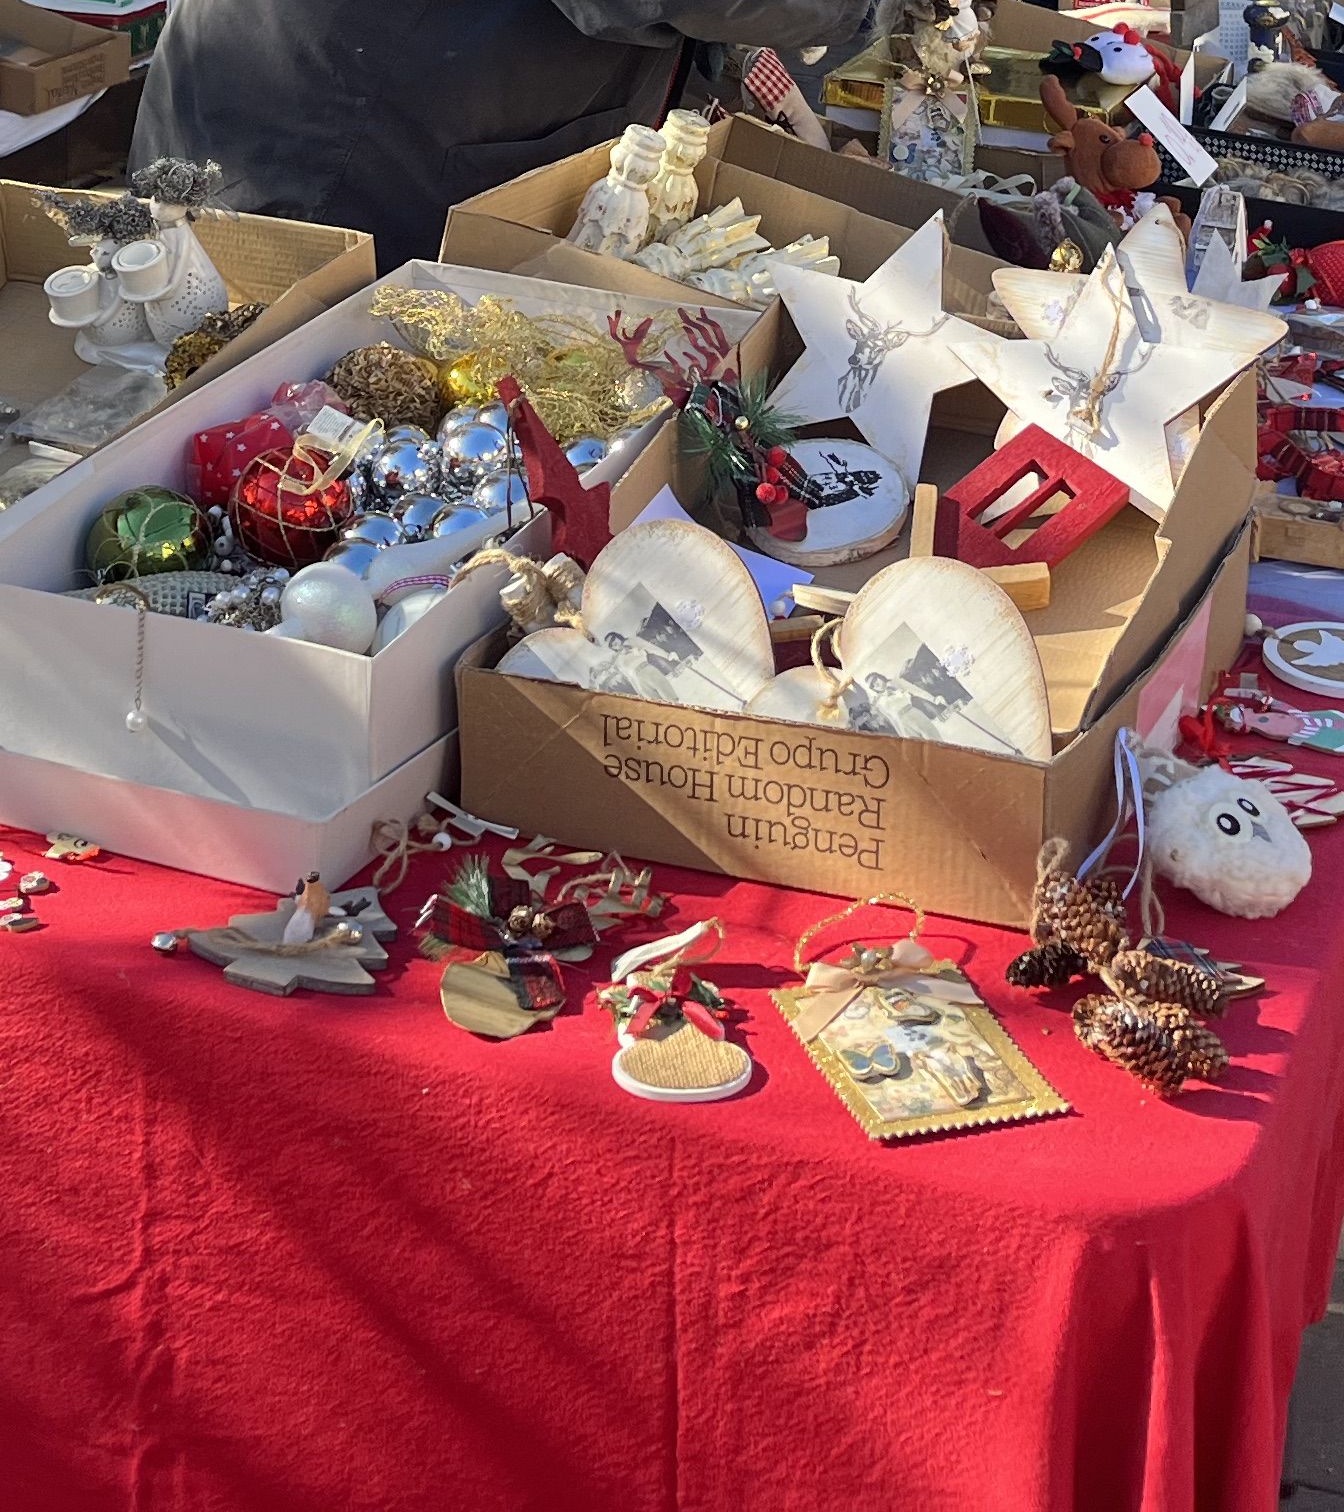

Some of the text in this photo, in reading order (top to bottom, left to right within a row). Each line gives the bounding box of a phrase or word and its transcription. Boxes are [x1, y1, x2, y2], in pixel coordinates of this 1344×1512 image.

[600, 713, 890, 789] Grupo Editorial
[603, 753, 887, 830] Random House
[724, 812, 885, 871] Penguin
